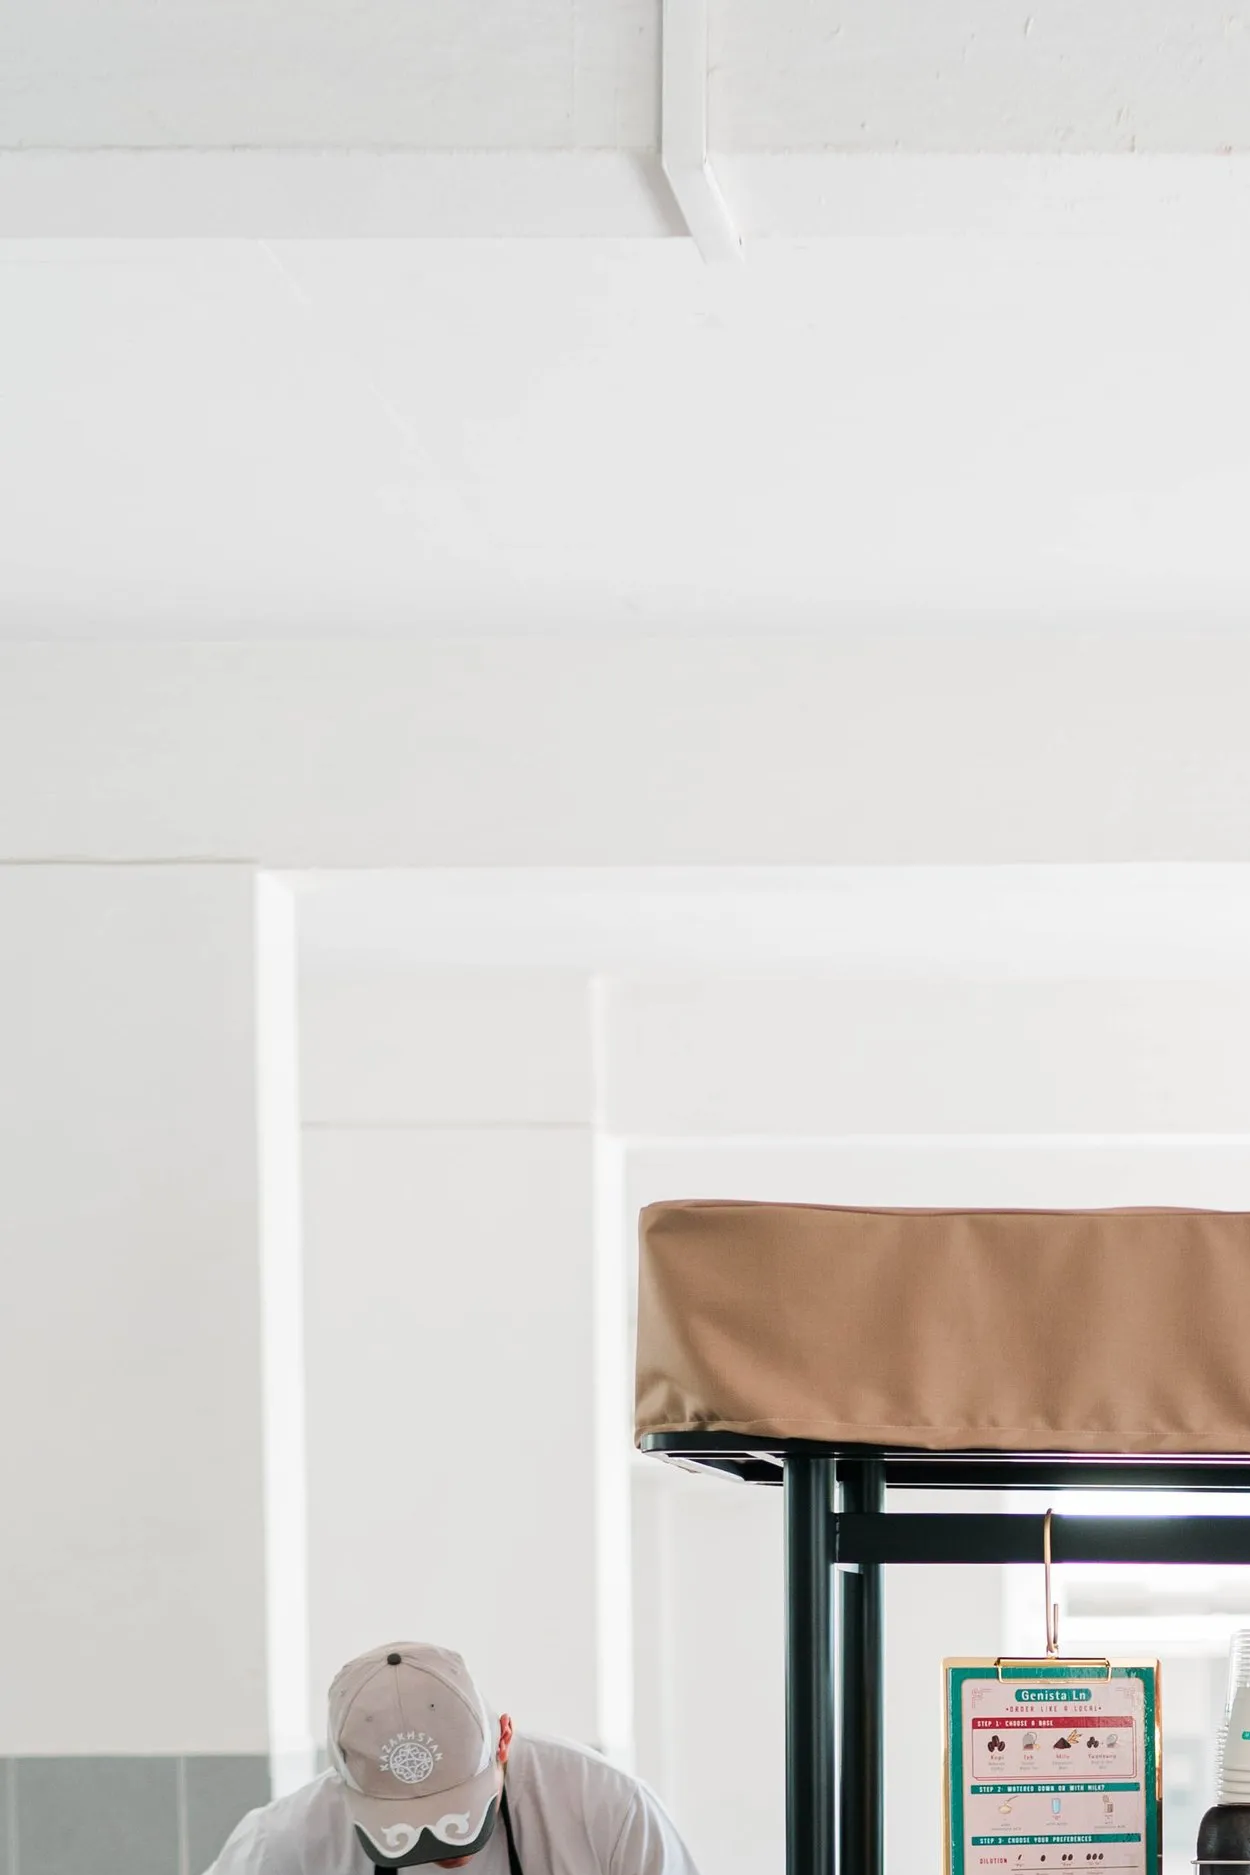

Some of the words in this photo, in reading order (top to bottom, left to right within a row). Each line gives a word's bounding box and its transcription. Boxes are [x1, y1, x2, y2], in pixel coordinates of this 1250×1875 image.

[1021, 1690, 1067, 1701] Genista
[1072, 1690, 1086, 1701] Ln
[380, 1730, 444, 1772] KAZAKHSTAN
[1037, 1785, 1055, 1793] DOWN
[979, 1837, 994, 1845] STEP
[1007, 1836, 1031, 1844] CHOOSE
[1033, 1836, 1049, 1844] YOUR
[1052, 1835, 1093, 1843] PREFERENCES
[979, 1857, 1008, 1865] DILUTION
